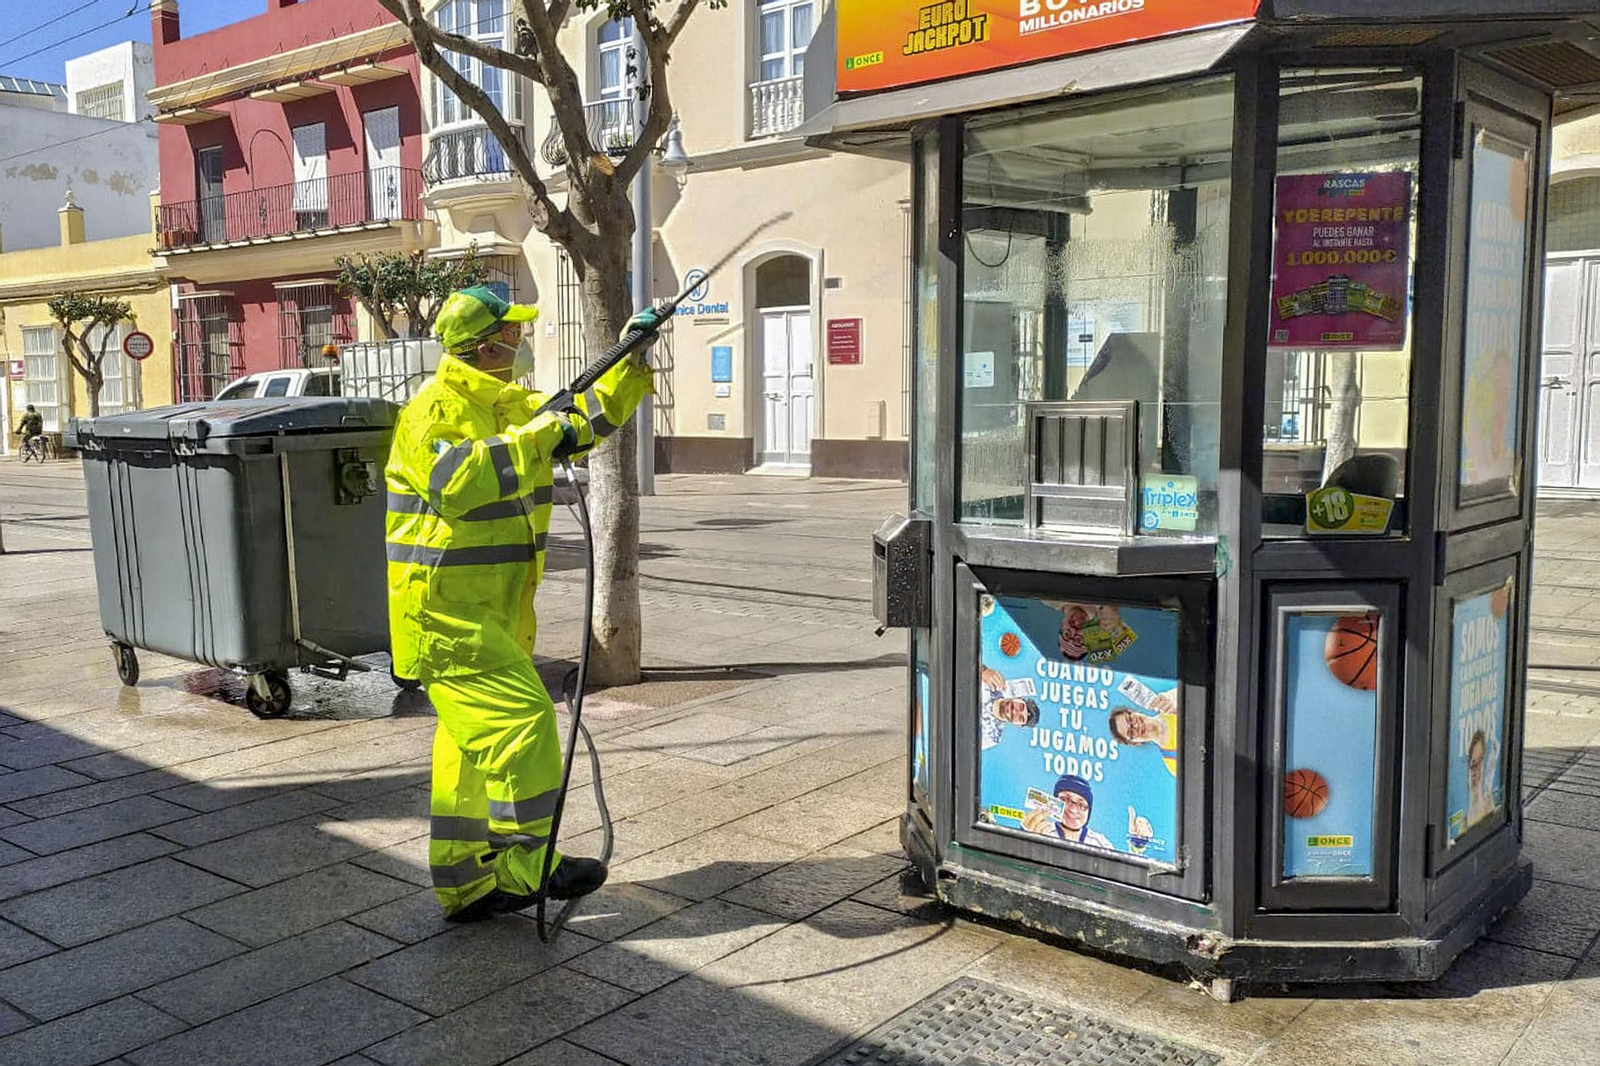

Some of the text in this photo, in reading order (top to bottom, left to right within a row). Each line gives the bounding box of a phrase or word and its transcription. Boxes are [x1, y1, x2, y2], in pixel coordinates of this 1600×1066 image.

[919, 0, 968, 29] EURO
[1019, 0, 1145, 33] MILLONARIOS
[902, 15, 987, 55] JACKPOT
[856, 53, 881, 66] ONCE
[1324, 178, 1366, 190] RASCAS
[1313, 226, 1375, 238] PUEDES GANAR
[698, 301, 729, 315] Dental
[1141, 486, 1198, 507] Triplex
[1312, 490, 1350, 522] +18
[1460, 616, 1500, 663] SOMOS
[1035, 657, 1114, 687] CUANDO
[1040, 680, 1109, 710] JUEGAS
[1030, 726, 1119, 760] JUGAMOS
[1043, 751, 1104, 782] TODOS
[1000, 807, 1024, 819] ONCE
[1320, 837, 1351, 845] ONCE
